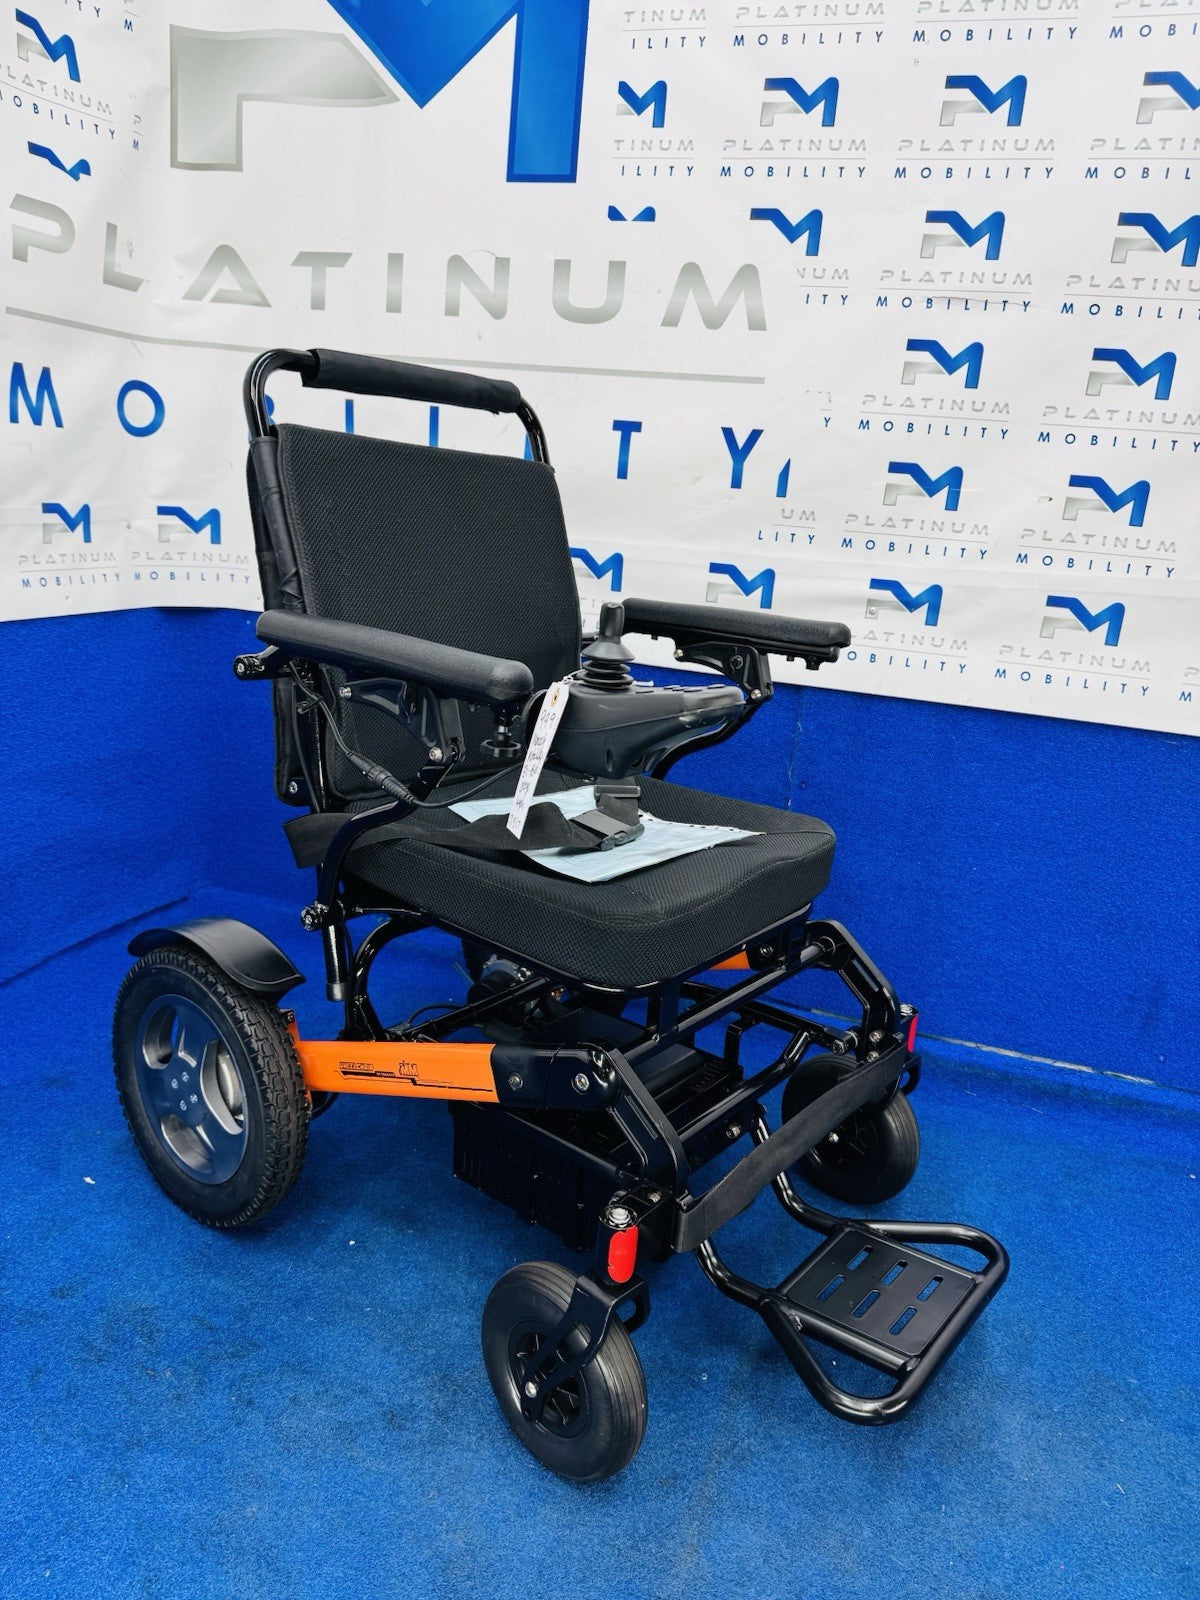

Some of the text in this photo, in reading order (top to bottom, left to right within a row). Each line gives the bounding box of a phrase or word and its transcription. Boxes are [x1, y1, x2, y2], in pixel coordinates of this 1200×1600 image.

[735, 2, 886, 20] PLATINUM
[732, 31, 884, 48] MOBILITY
[912, 26, 1078, 43] MOBILITY
[722, 138, 868, 152] PLATINUM
[897, 138, 1056, 152] PLATINUM
[719, 166, 866, 179] MOBILITY
[893, 166, 1055, 180] MOBILITY
[8, 193, 768, 332] PLATINUM
[879, 269, 1033, 287] PLATINUM
[875, 295, 1032, 314] MOBILITY
[861, 393, 1012, 415] PLATINUM
[857, 418, 1010, 441] MOBILITY
[1037, 431, 1200, 453] MOBILITY
[843, 513, 990, 537] PLATINUM
[840, 537, 988, 561] MOBILITY
[1019, 527, 1178, 555] PLATINUM
[18, 551, 117, 566] PLATINUM
[131, 550, 250, 566] PLATINUM
[1015, 552, 1175, 579] MOBILITY
[21, 572, 121, 589] MOBILITY
[133, 571, 251, 585] MOBILITY
[998, 643, 1152, 673] PLATINUM
[994, 667, 1150, 697] MOBILITY
